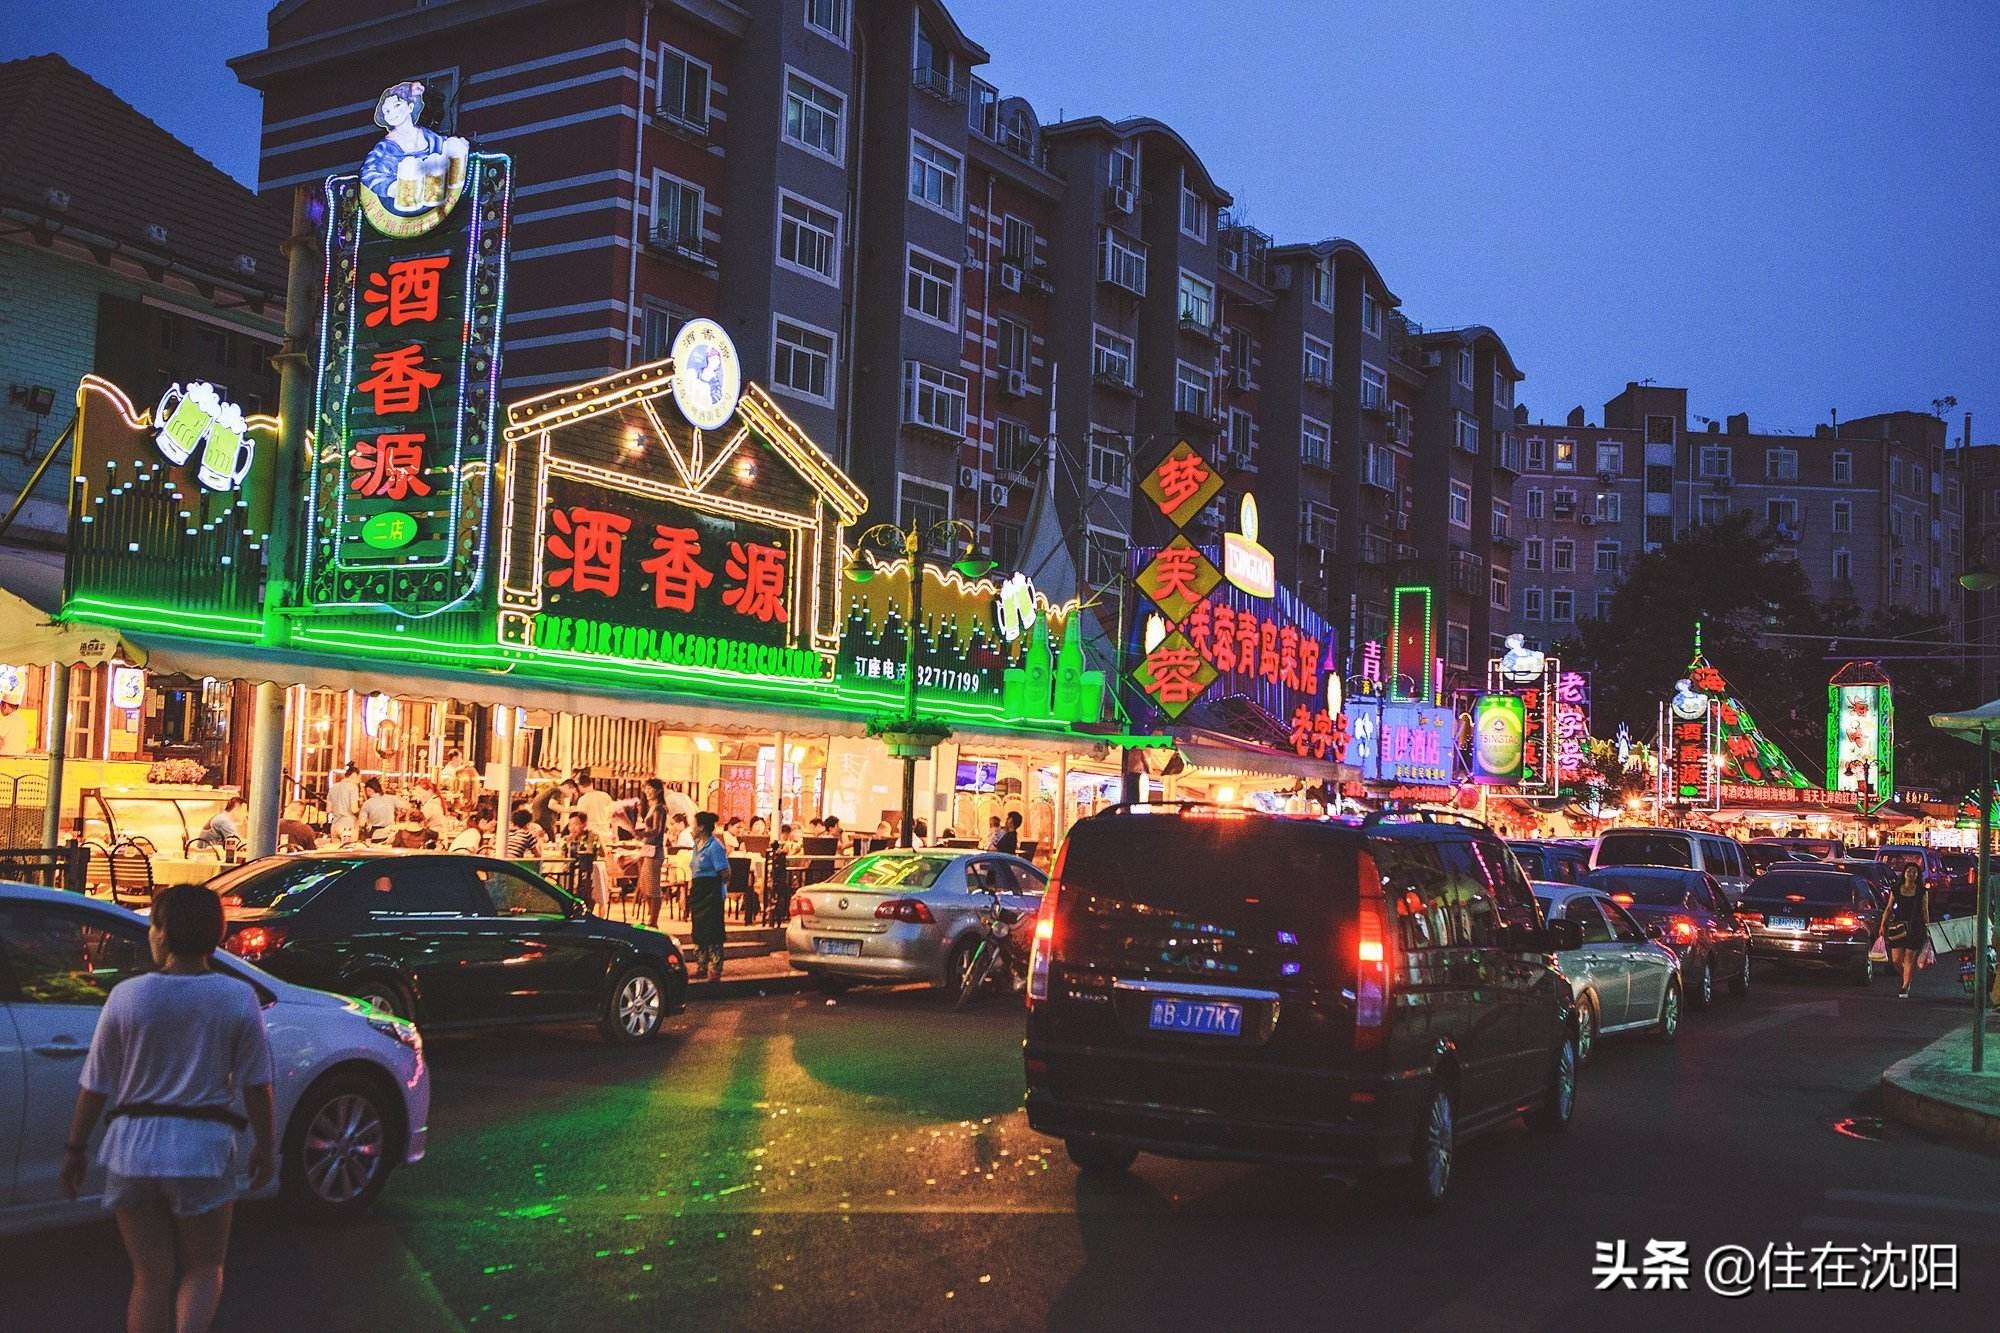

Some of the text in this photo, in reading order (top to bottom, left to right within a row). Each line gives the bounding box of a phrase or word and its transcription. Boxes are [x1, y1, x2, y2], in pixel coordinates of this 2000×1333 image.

[350, 256, 450, 499] 酒香源
[373, 519, 405, 541] 二店
[546, 506, 788, 624] 酒香源
[1144, 452, 1209, 704] 梦芙蓉
[534, 613, 572, 650] THE
[1166, 598, 1320, 695] 芙蓉青岛菜馆
[1479, 733, 1521, 746] TSINGTAO
